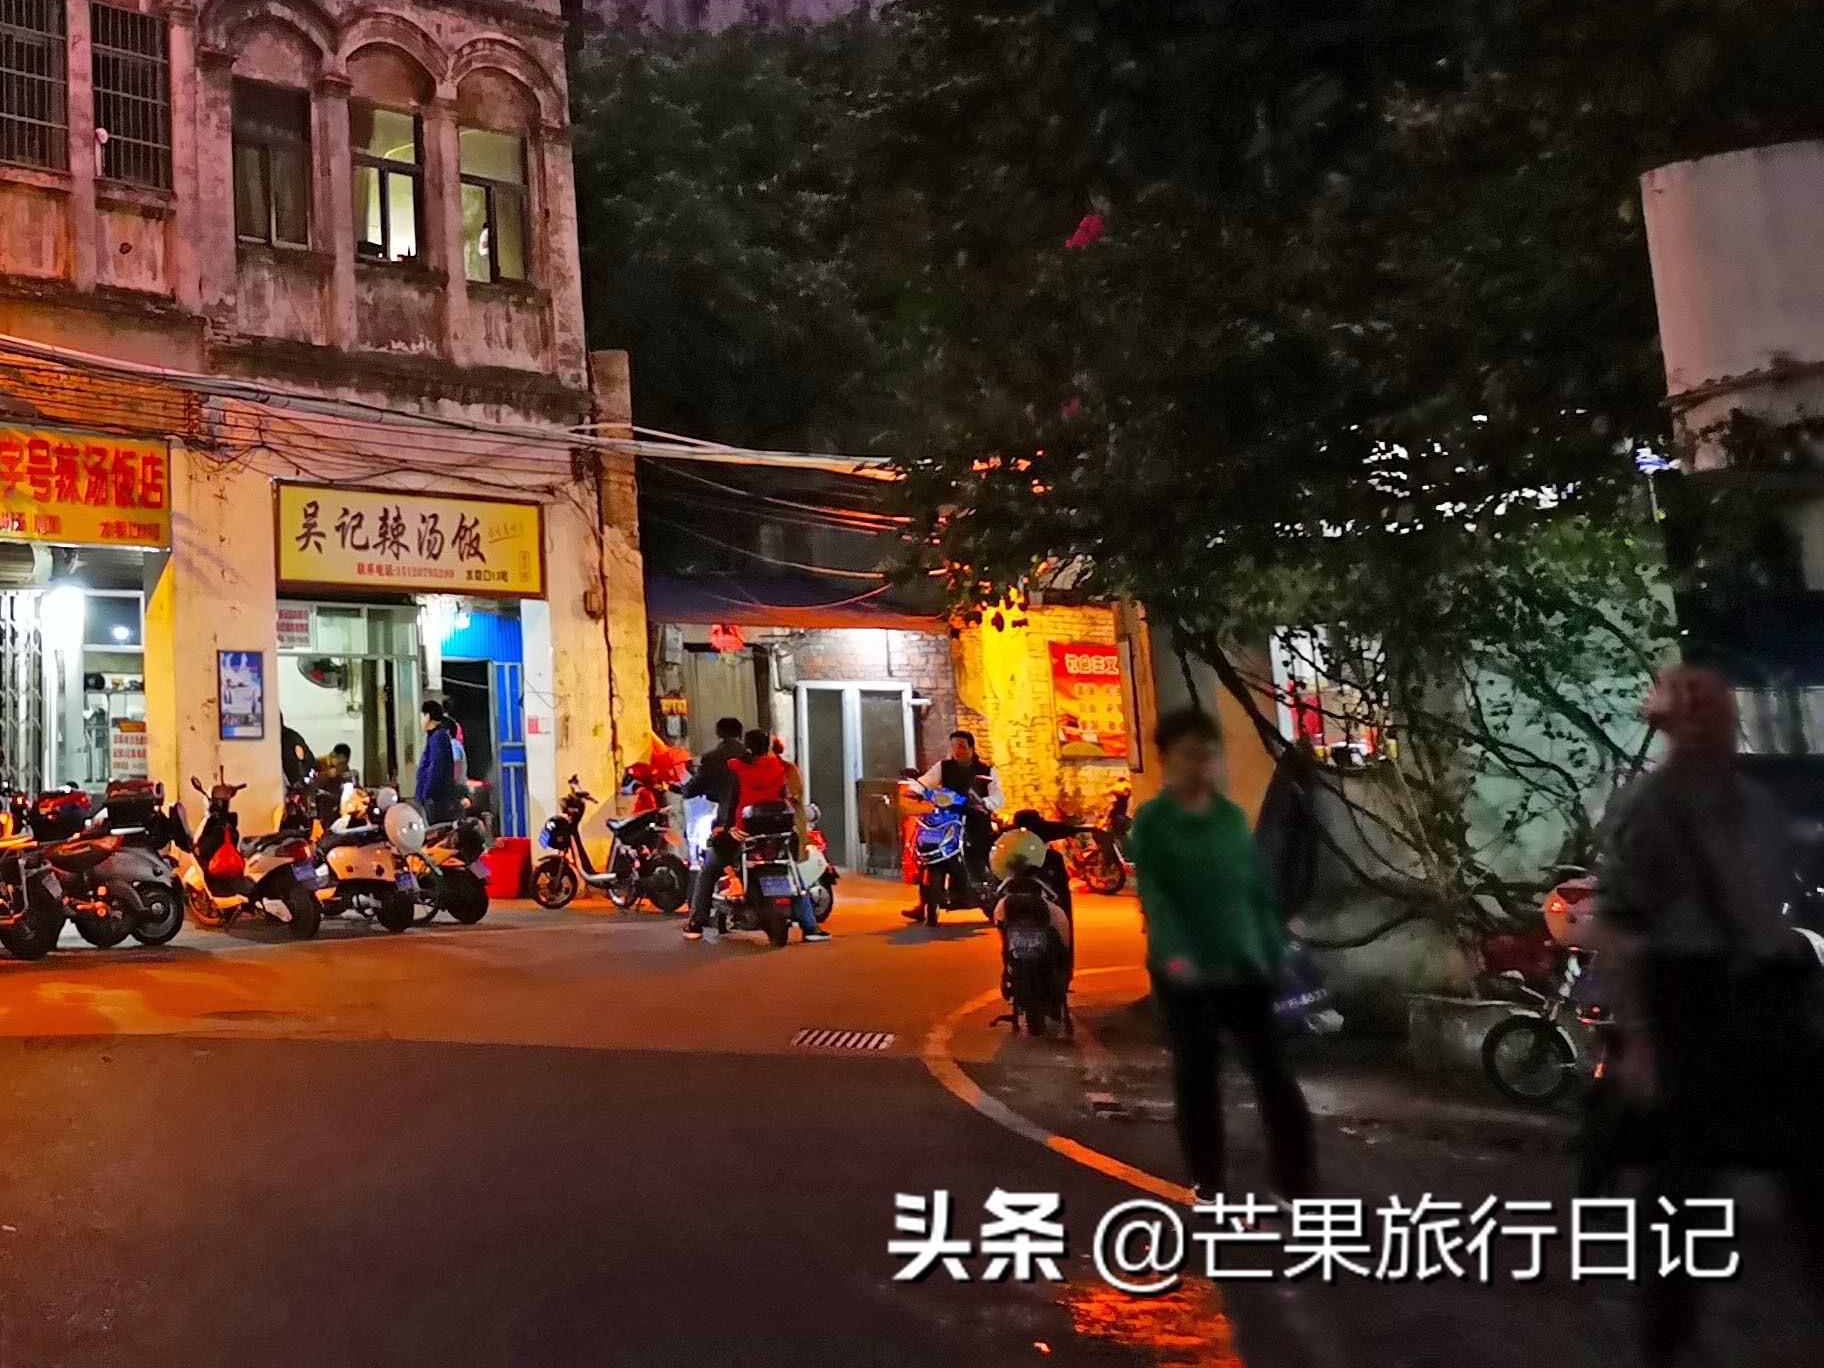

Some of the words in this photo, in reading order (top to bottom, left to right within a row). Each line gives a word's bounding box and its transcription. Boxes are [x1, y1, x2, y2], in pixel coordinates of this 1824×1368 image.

[295, 499, 486, 564] 吴记辣汤饭
